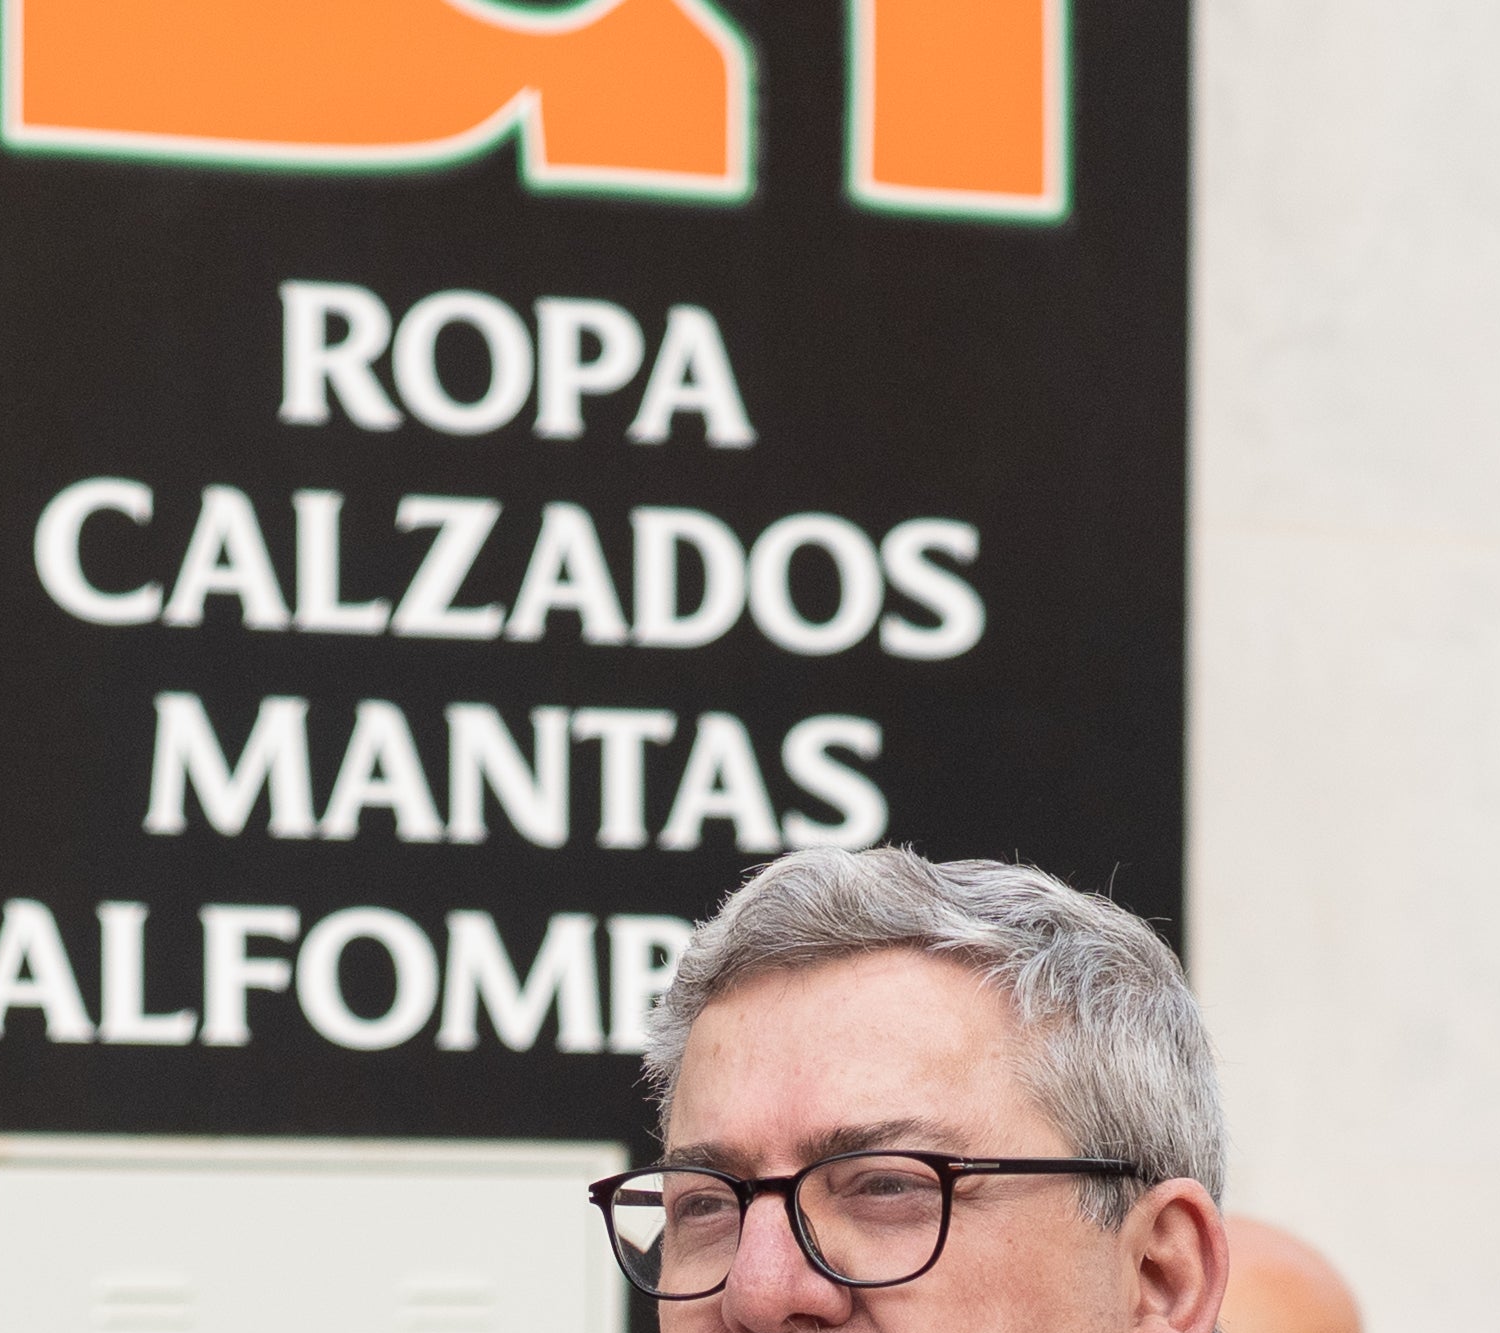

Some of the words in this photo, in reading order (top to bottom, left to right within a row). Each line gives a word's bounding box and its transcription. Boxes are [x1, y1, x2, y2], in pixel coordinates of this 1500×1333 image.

[276, 279, 756, 448] ROPA
[32, 475, 987, 660] CALZADOS
[143, 692, 888, 853] MANTAS
